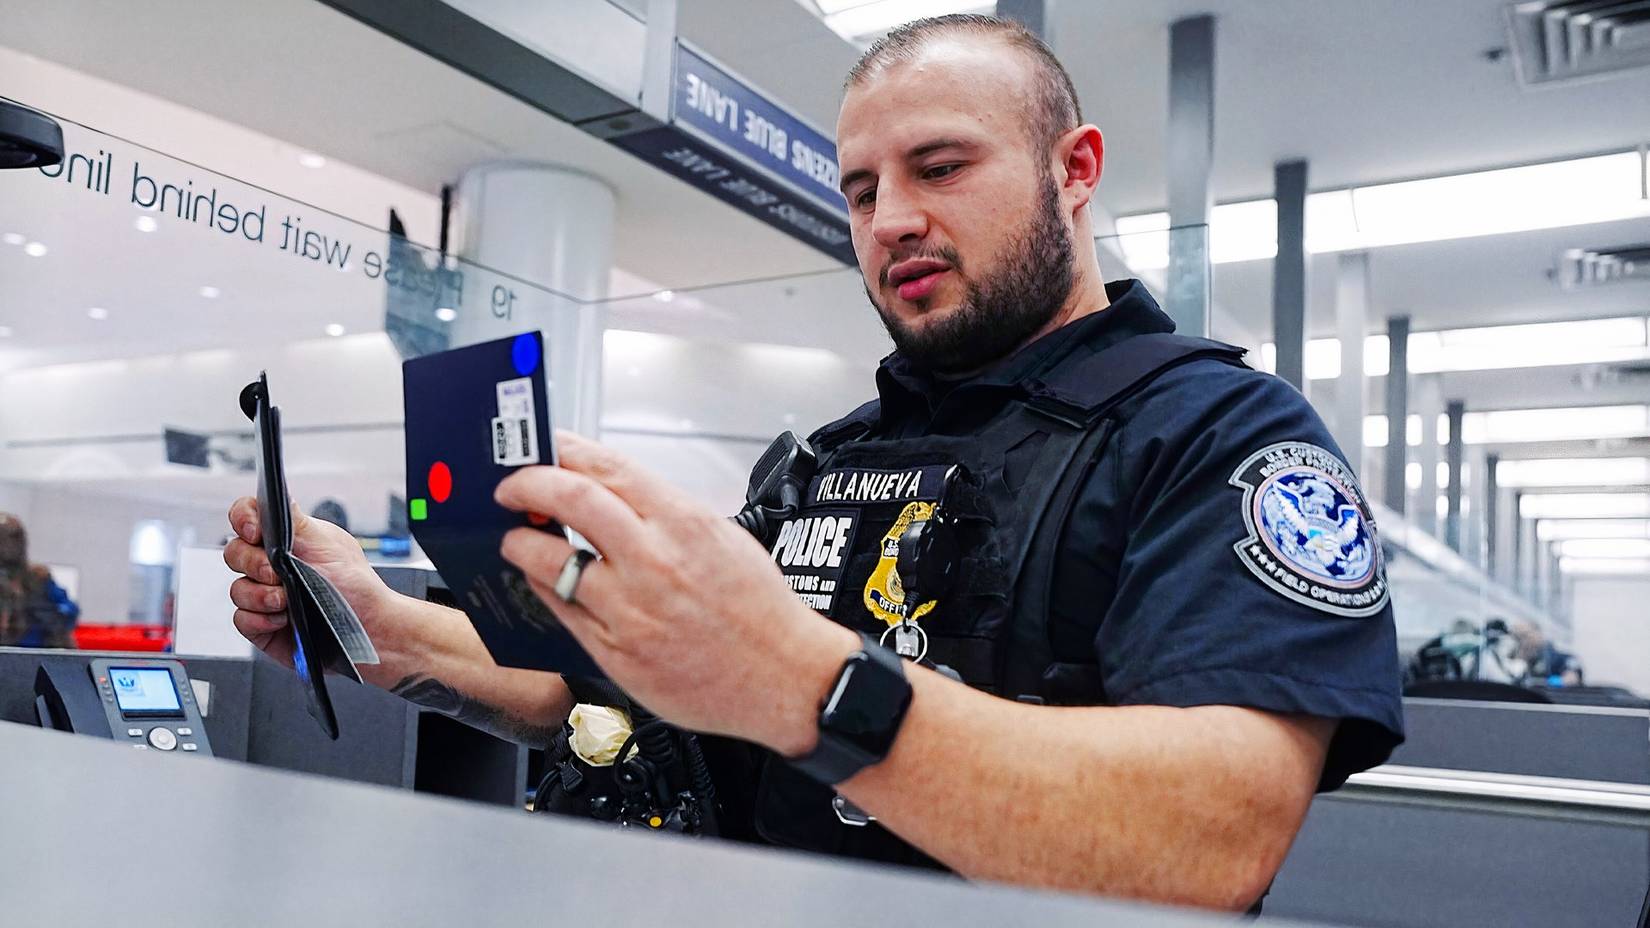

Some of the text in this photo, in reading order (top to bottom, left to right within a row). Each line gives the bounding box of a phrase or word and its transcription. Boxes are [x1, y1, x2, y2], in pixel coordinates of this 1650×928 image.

[686, 73, 739, 132] LANE
[744, 109, 788, 161] BLUE
[816, 470, 923, 502] VILLANUEVA
[771, 516, 853, 568] POLICE
[820, 580, 836, 592] AND
[1274, 567, 1310, 593] FIELD
